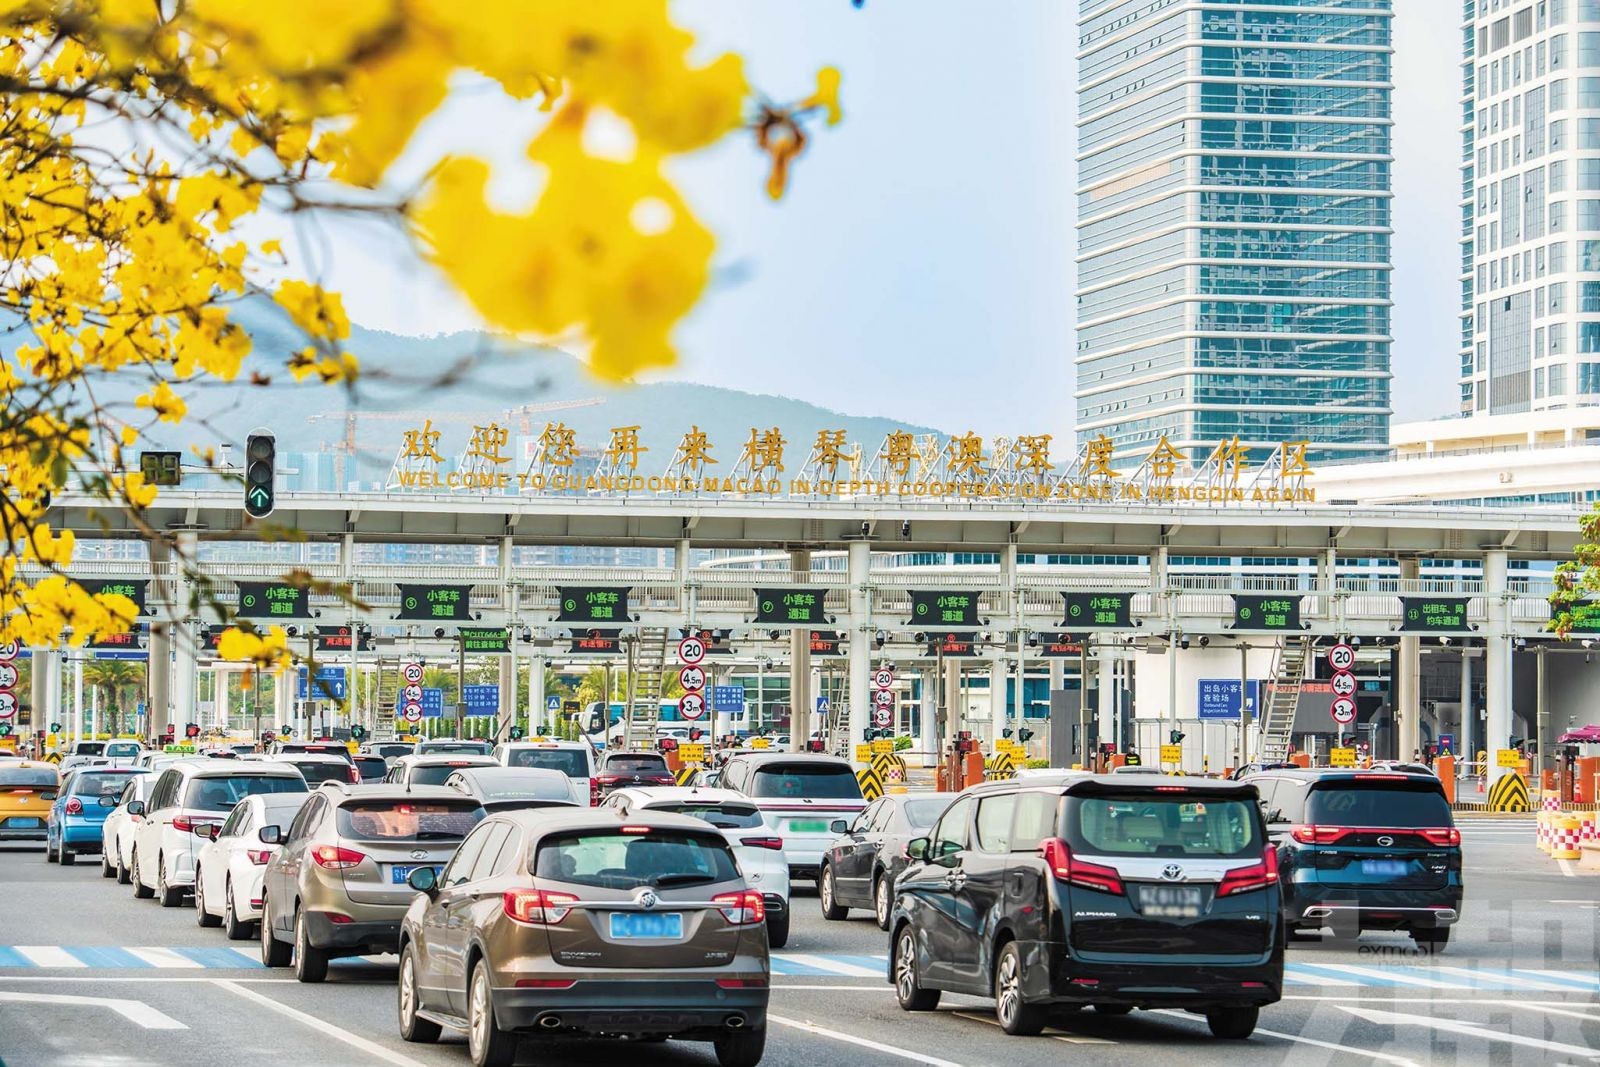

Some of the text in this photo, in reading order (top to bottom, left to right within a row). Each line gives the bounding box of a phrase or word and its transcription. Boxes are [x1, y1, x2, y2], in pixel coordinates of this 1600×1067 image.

[401, 419, 1315, 482] 欢迎您再来横琴粤澳深度合作区
[398, 471, 509, 488] WELCOME
[517, 473, 546, 489] TO
[898, 481, 1051, 499] COOPERATION
[1056, 483, 1112, 500] ZONE
[1121, 484, 1142, 500] IN
[1150, 485, 1244, 502] HENGQIN
[1252, 487, 1315, 502] AGAIN
[265, 587, 299, 600] 小客车
[427, 590, 460, 602] 小客车
[586, 592, 619, 604] 小客车
[783, 594, 815, 606] 小客车
[937, 596, 969, 608] 小客车
[1090, 598, 1121, 609] 小客车
[1260, 600, 1291, 612] 小客车
[271, 602, 293, 614] 通道
[432, 604, 454, 616] 通道
[591, 606, 613, 618] 通道
[788, 608, 810, 620] 通道
[942, 611, 963, 622] 通道
[1095, 612, 1116, 623] 通道
[1265, 615, 1286, 626] 通道
[684, 644, 701, 657] 20
[1335, 651, 1351, 664] 20
[408, 669, 419, 678] 20
[683, 673, 702, 685] 4.5m
[879, 674, 890, 683] 20
[1204, 684, 1242, 693] 出岛小客
[1335, 679, 1353, 690] 4.5m
[685, 700, 700, 712] 3m
[1337, 705, 1351, 717] 3m
